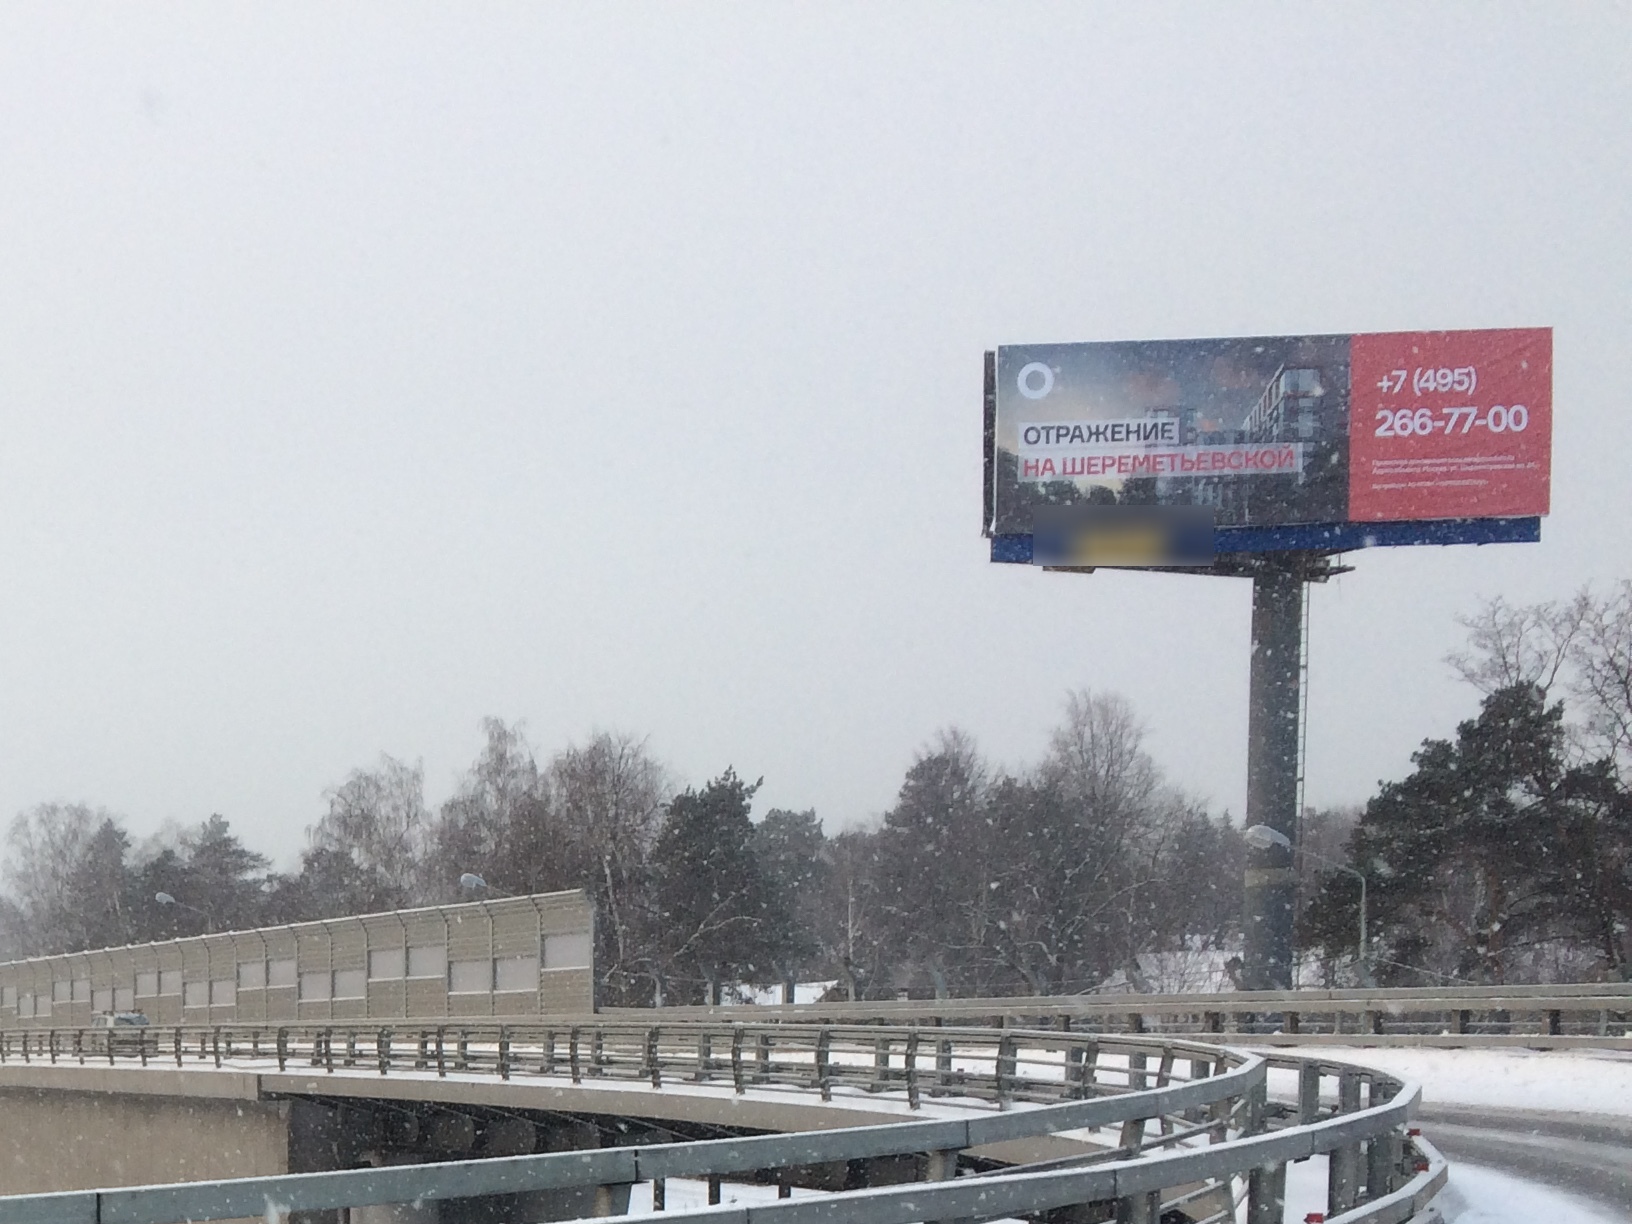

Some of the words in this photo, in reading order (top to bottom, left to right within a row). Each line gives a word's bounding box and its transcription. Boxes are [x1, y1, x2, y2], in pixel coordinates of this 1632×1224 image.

[1377, 369, 1408, 394] +7
[1412, 366, 1478, 396] (495)
[1023, 421, 1176, 446] ОТРАЖЕНИЕ
[1374, 404, 1529, 438] 266-77-00
[1023, 457, 1056, 478] НА
[1062, 445, 1296, 476] ШЕРЕМЕТЬЕВСКОЙ
